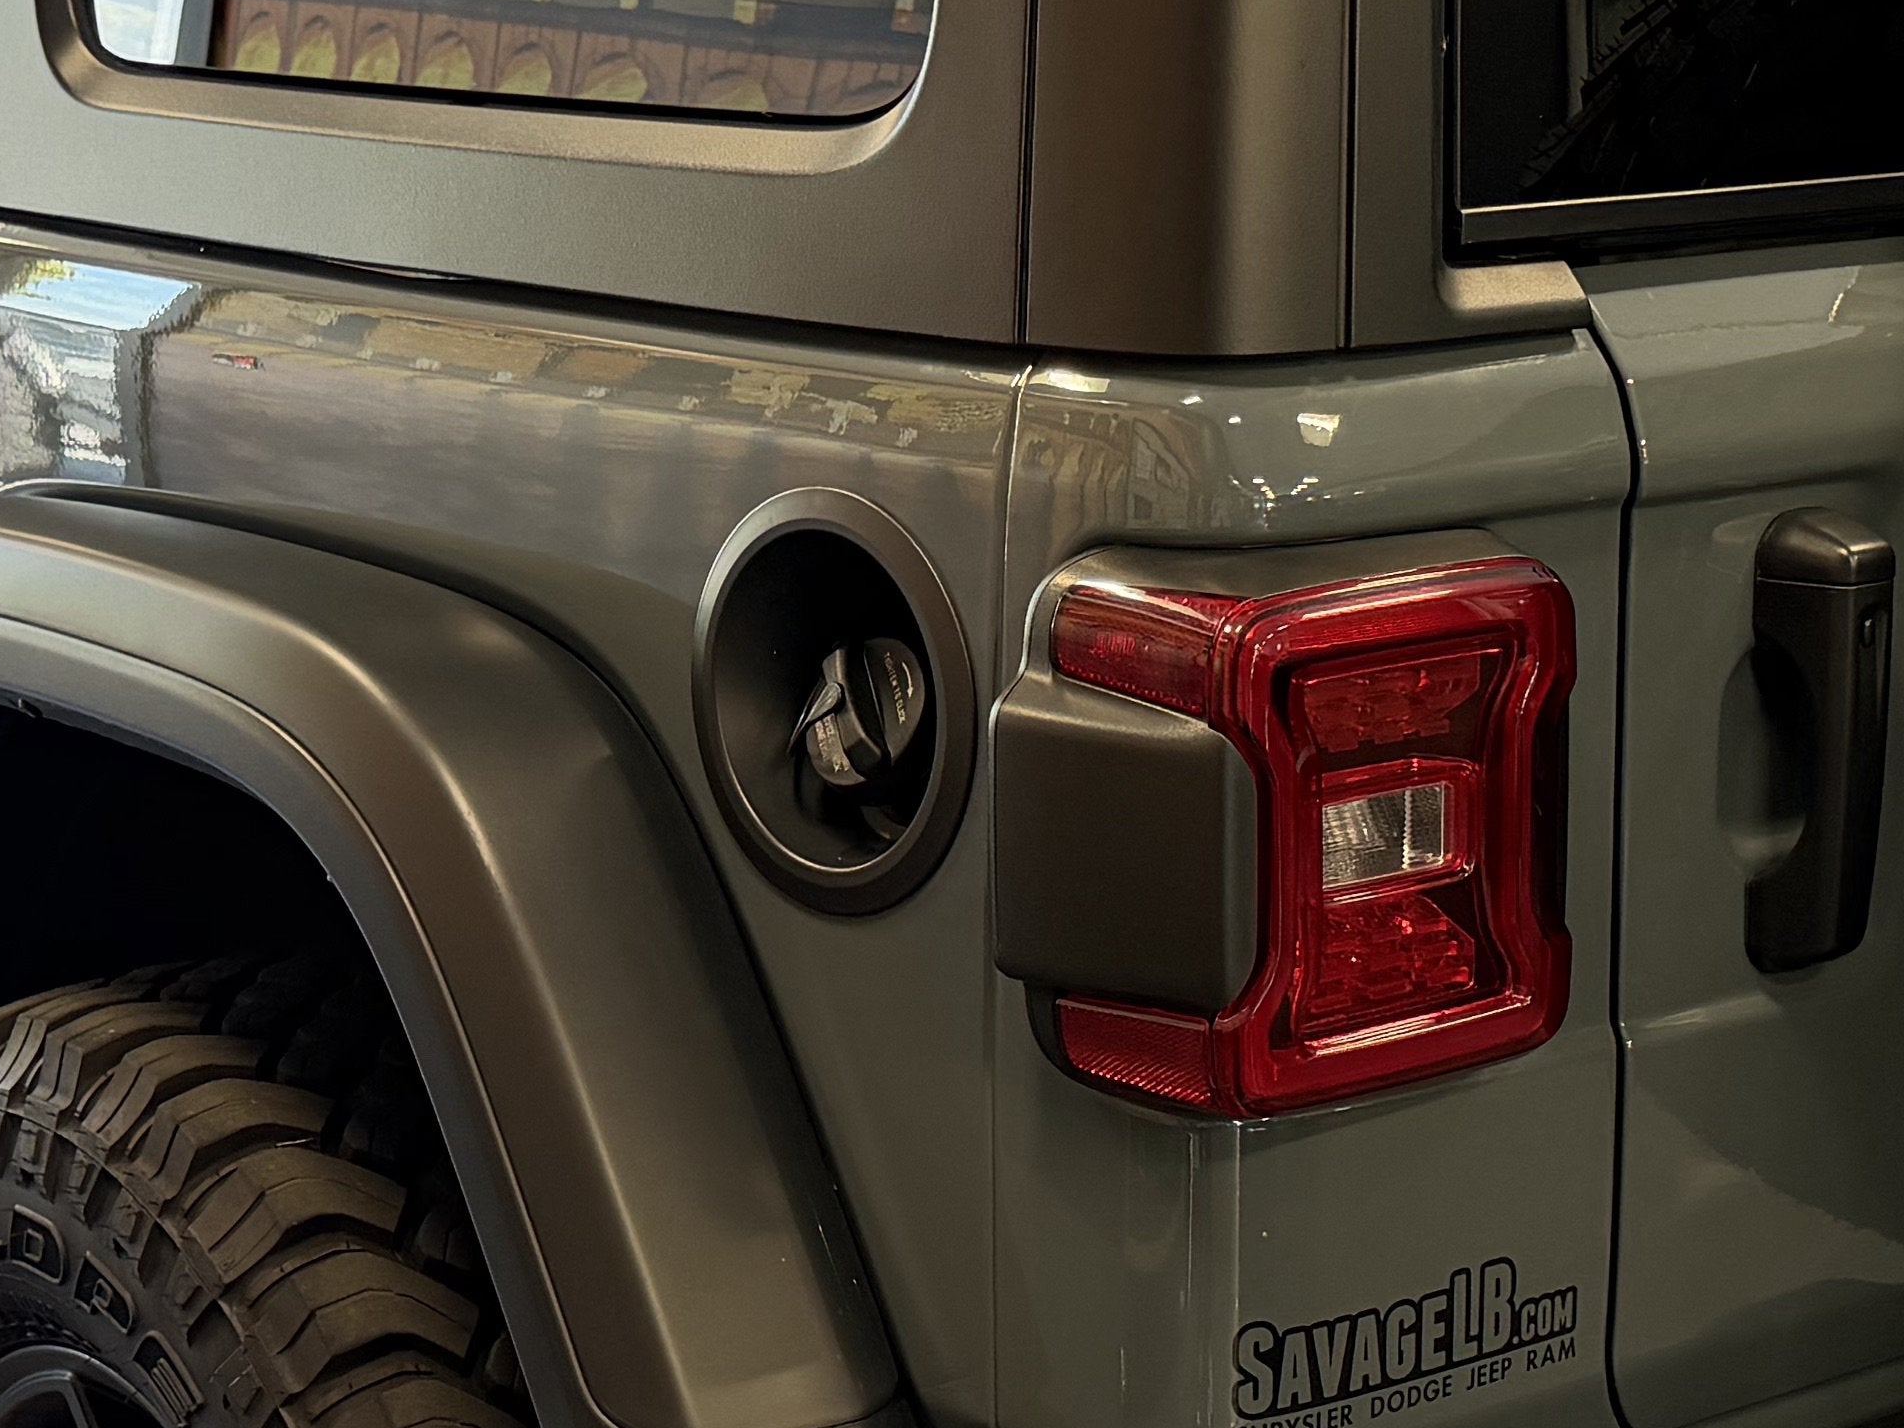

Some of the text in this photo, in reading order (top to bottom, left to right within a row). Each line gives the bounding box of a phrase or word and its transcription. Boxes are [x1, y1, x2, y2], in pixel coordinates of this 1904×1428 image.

[1370, 1375, 1453, 1419] DODGE
[1466, 1357, 1512, 1392] JEEP
[1525, 1337, 1576, 1372] RAM
